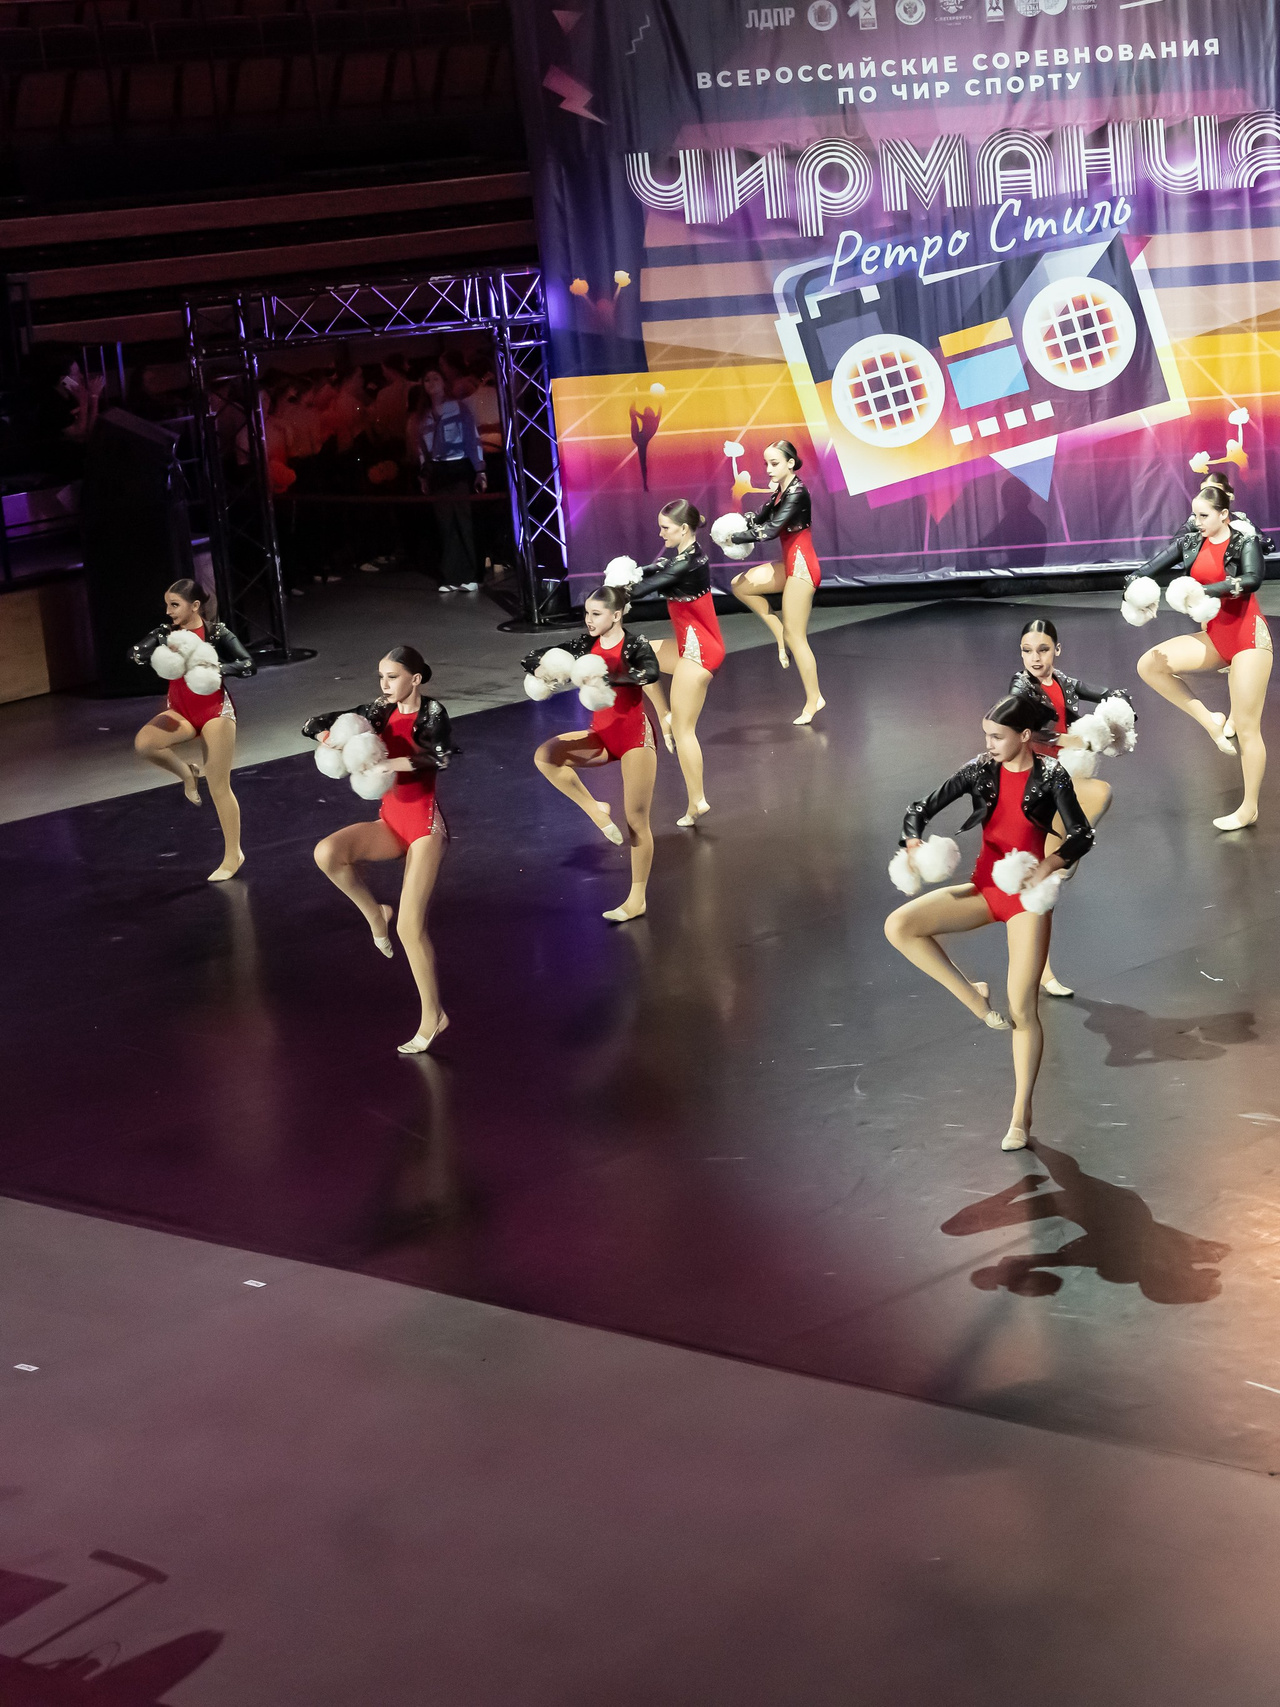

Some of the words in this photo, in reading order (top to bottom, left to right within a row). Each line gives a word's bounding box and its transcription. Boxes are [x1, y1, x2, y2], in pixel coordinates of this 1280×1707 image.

[746, 8, 795, 30] ЛДПР
[697, 56, 958, 89] ВСЕРОССИЙСКИЕ
[972, 38, 1220, 71] СОРЕВНОВАНИЯ
[838, 85, 877, 104] ПО
[891, 81, 950, 100] ЧИР
[965, 72, 1082, 96] СПОРТУ
[829, 229, 970, 286] Ретро
[990, 196, 1132, 253] Стиль
